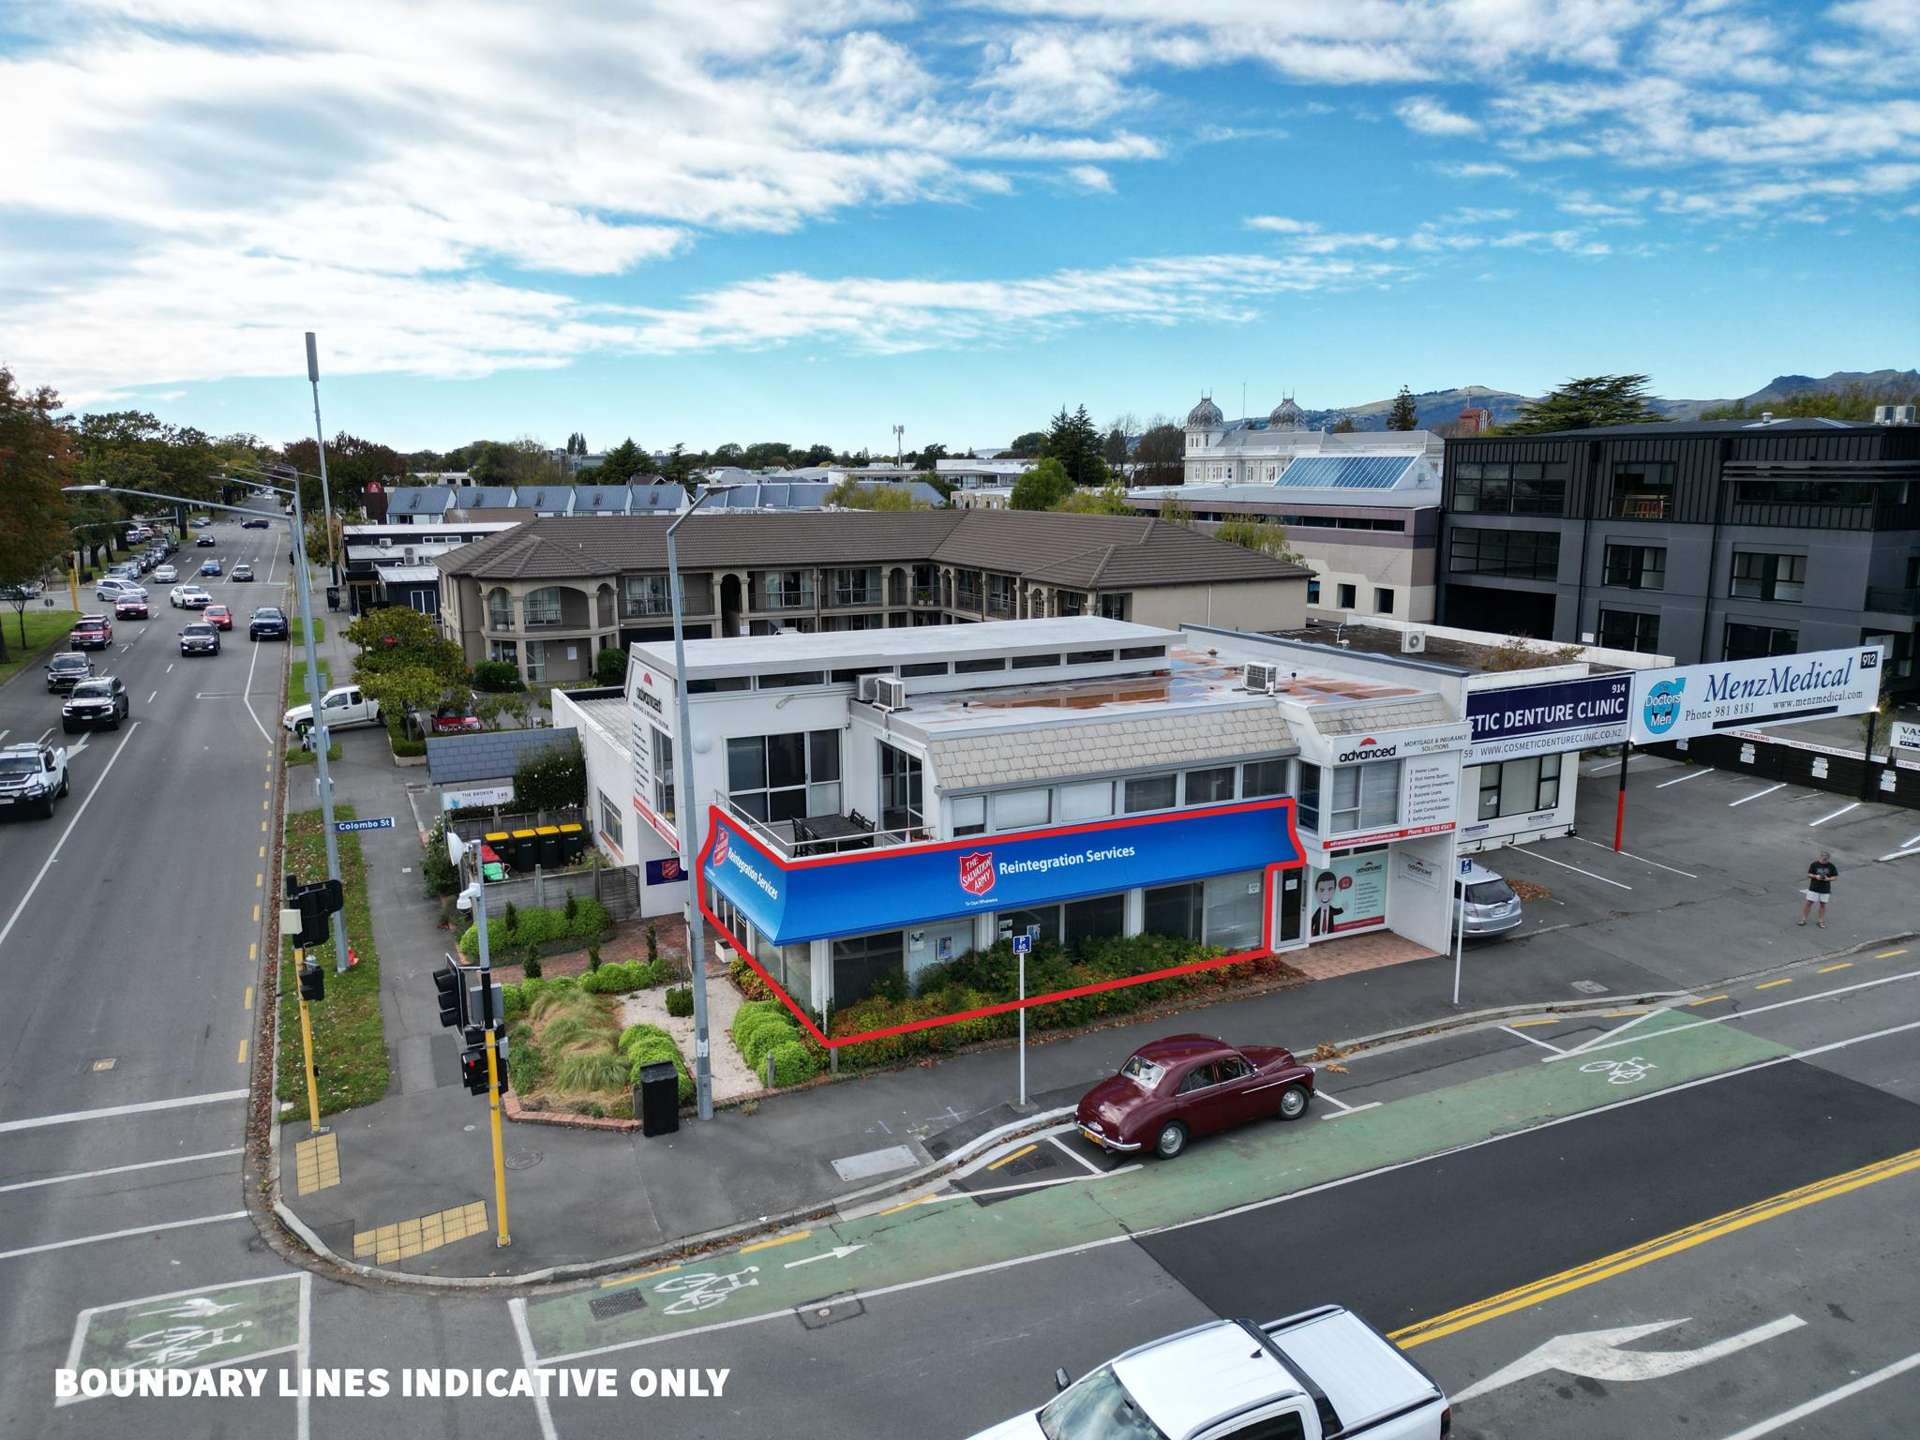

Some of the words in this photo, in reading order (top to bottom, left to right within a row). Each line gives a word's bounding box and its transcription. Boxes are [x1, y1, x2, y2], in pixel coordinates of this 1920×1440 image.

[1862, 654, 1876, 666] 912
[1612, 683, 1625, 694] 914
[1704, 657, 1853, 702] MenzMedical
[1772, 689, 1863, 710] www.menzmedical.com
[1504, 703, 1575, 729] DENTURE
[1577, 697, 1625, 717] CLINIC
[1651, 715, 1672, 727] Men
[1685, 709, 1711, 721] Phone
[1715, 705, 1730, 717] 981
[1733, 702, 1754, 714] 8181
[1339, 744, 1397, 763] advanced
[339, 820, 378, 831] Colombo
[380, 819, 390, 827] St
[966, 856, 978, 871] THE
[999, 853, 1084, 875] Reintegration
[1086, 845, 1136, 863] Services
[728, 847, 758, 882] Reintegration
[757, 872, 778, 900] Services
[963, 856, 992, 887] SALVATION
[974, 868, 990, 892] ARMY
